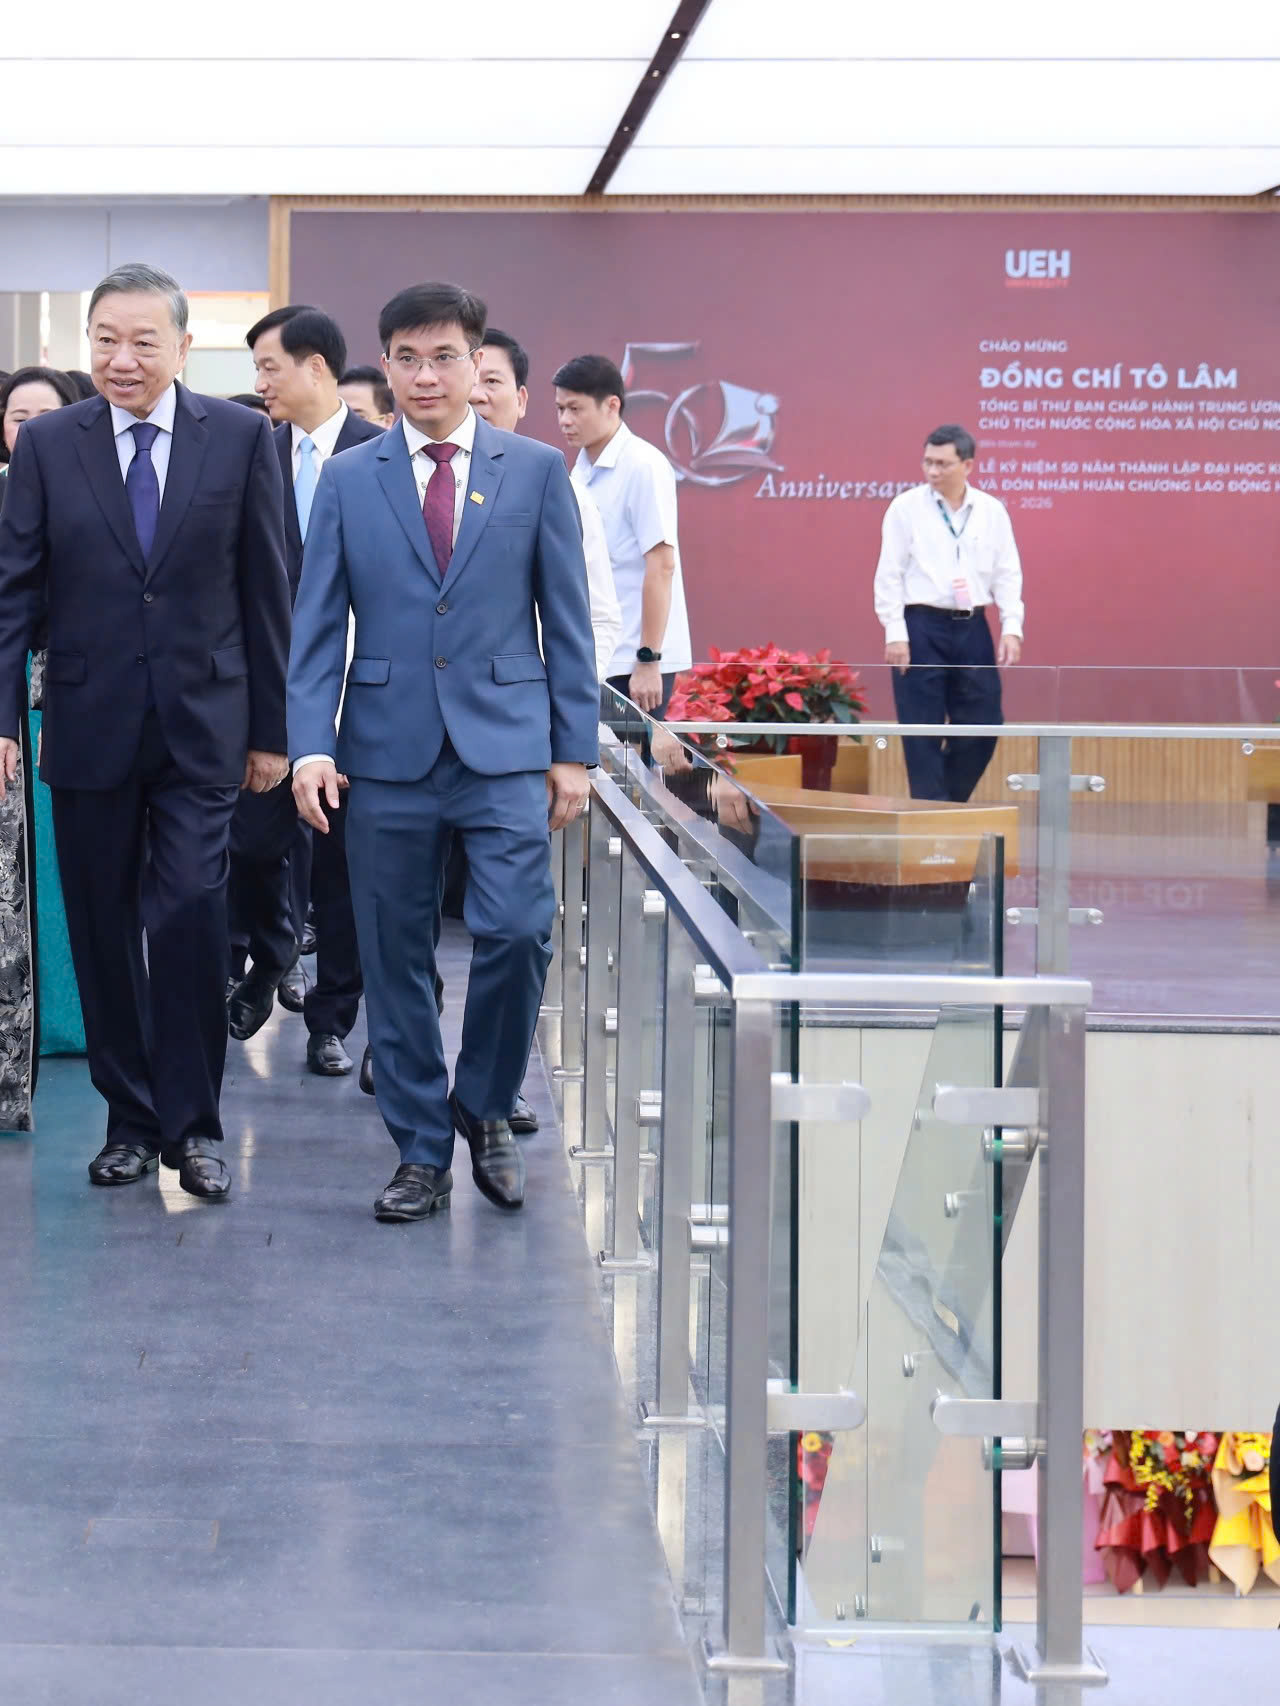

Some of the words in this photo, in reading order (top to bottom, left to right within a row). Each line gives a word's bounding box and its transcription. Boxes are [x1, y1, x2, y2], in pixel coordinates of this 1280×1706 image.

[1005, 249, 1070, 279] UEH
[1071, 362, 1122, 389] CHÍ
[1129, 362, 1168, 389] TÔ
[1177, 362, 1238, 389] LÂM
[1074, 399, 1105, 413] BAN
[1198, 399, 1248, 413] TRUNG
[1061, 461, 1079, 473] 50
[1194, 480, 1224, 492] LAO
